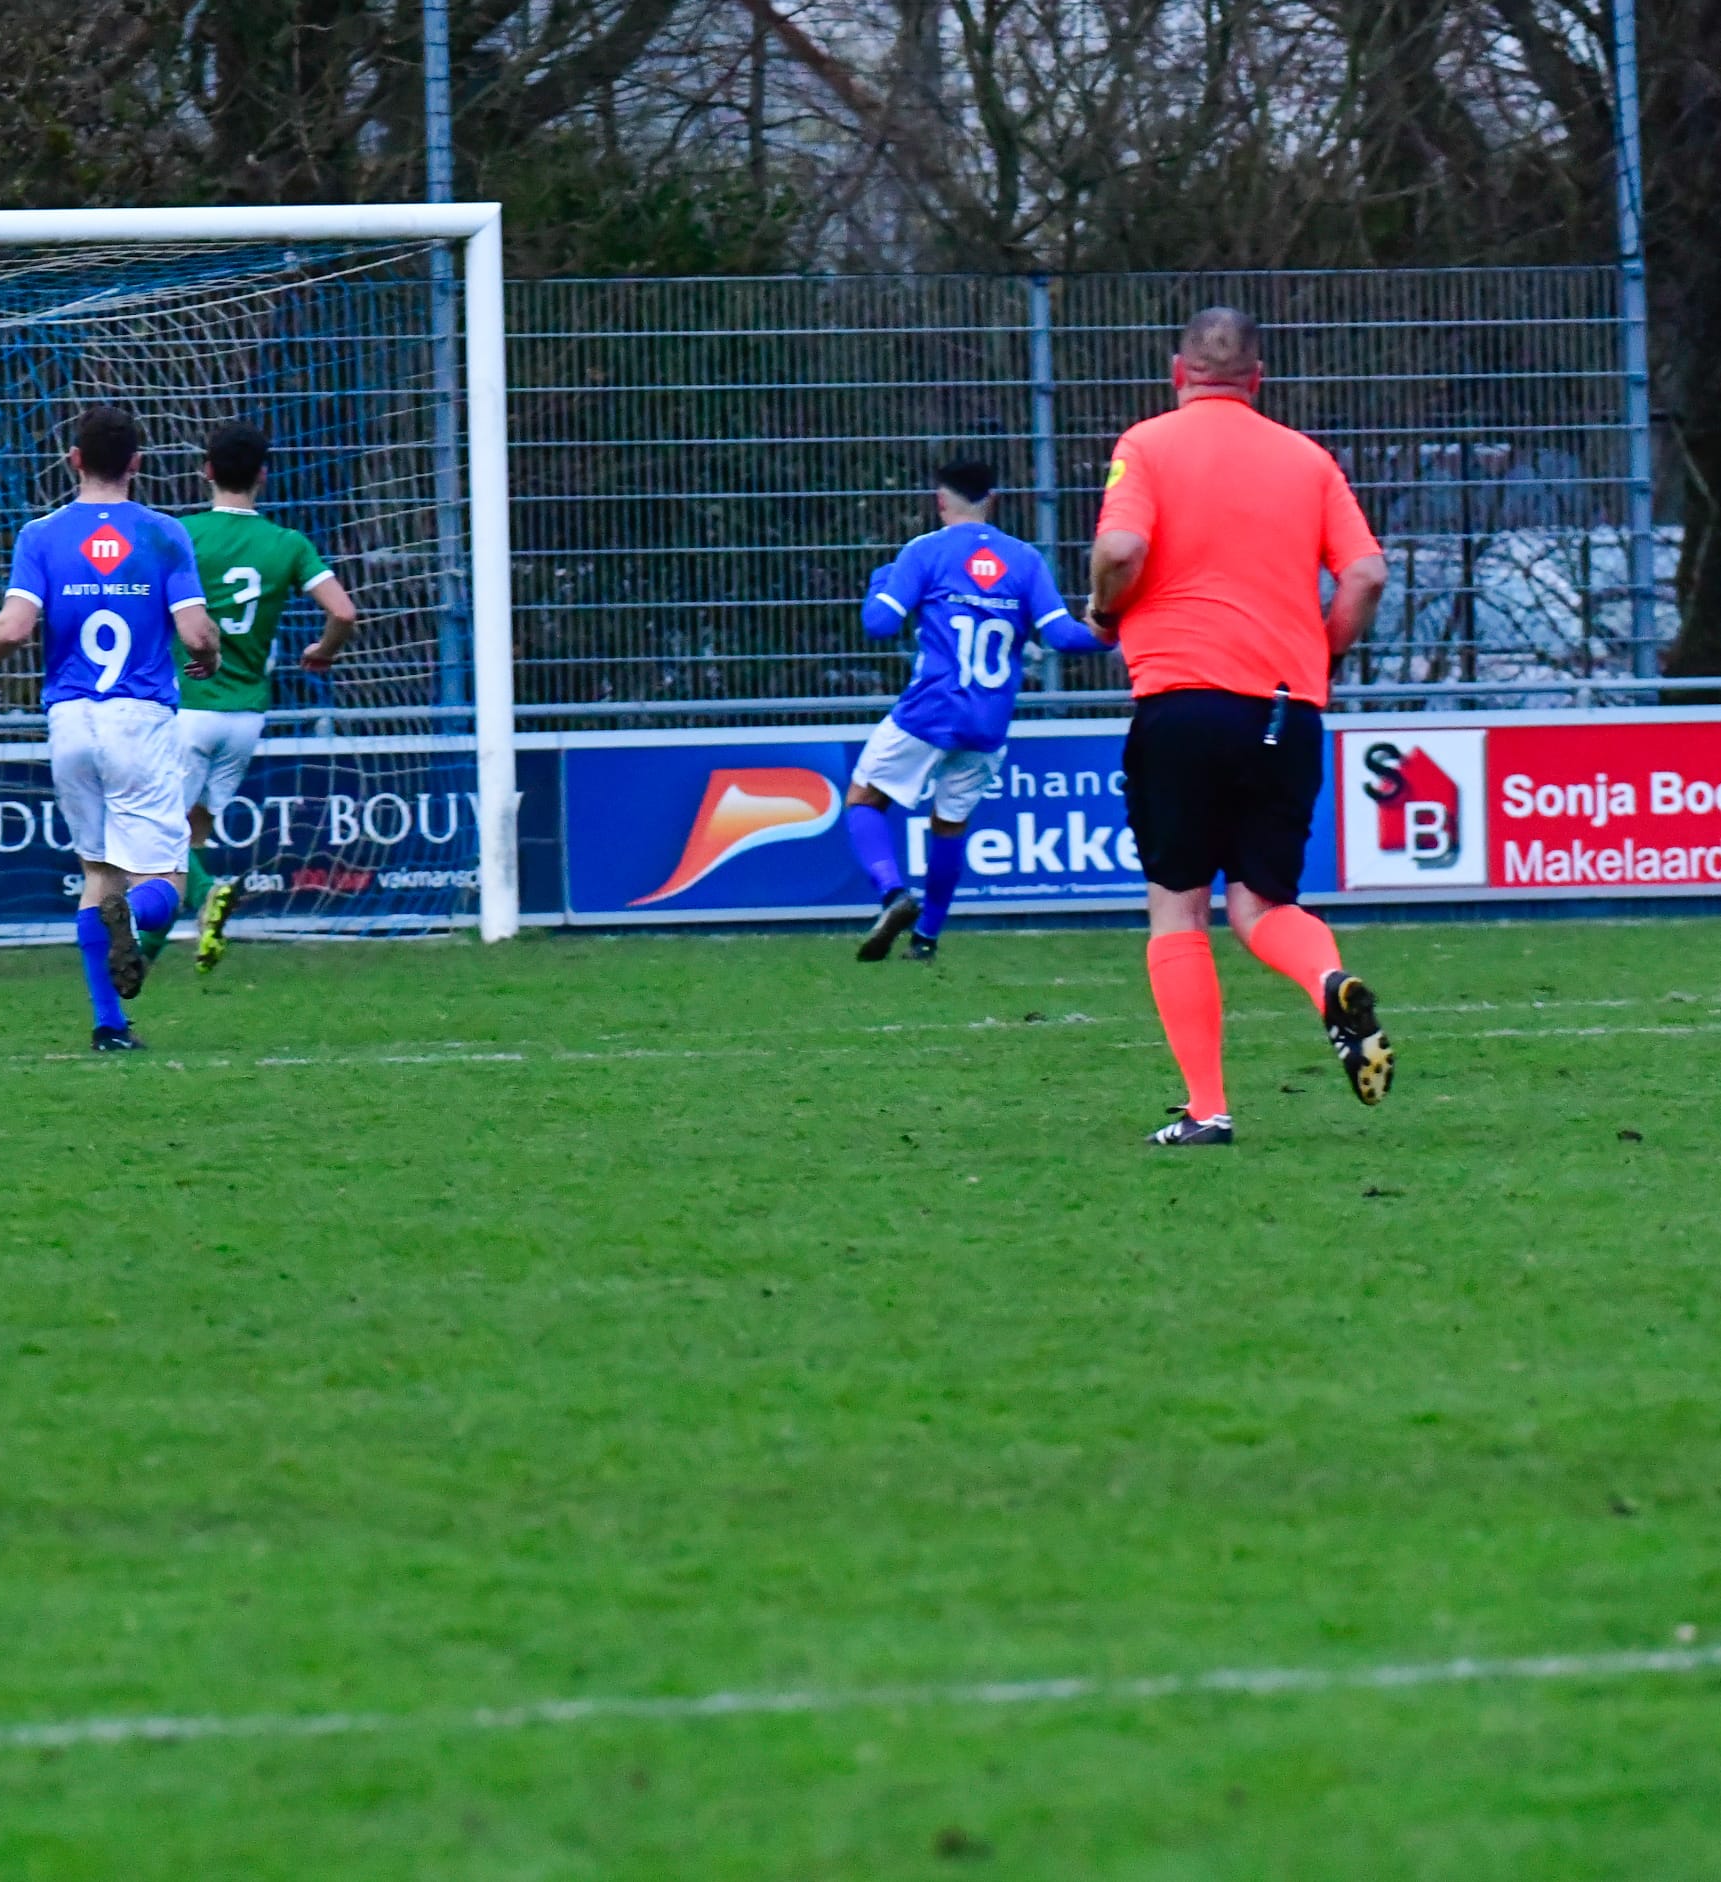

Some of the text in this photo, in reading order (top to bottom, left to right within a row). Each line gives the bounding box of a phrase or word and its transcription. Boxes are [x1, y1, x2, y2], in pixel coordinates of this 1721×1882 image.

[92, 539, 120, 558] m
[972, 559, 997, 577] m
[62, 583, 151, 596] AUTO MELSE
[220, 566, 262, 635] 3
[80, 609, 132, 693] 9
[949, 615, 1015, 688] 10
[1502, 771, 1721, 827] Sonja Bo
